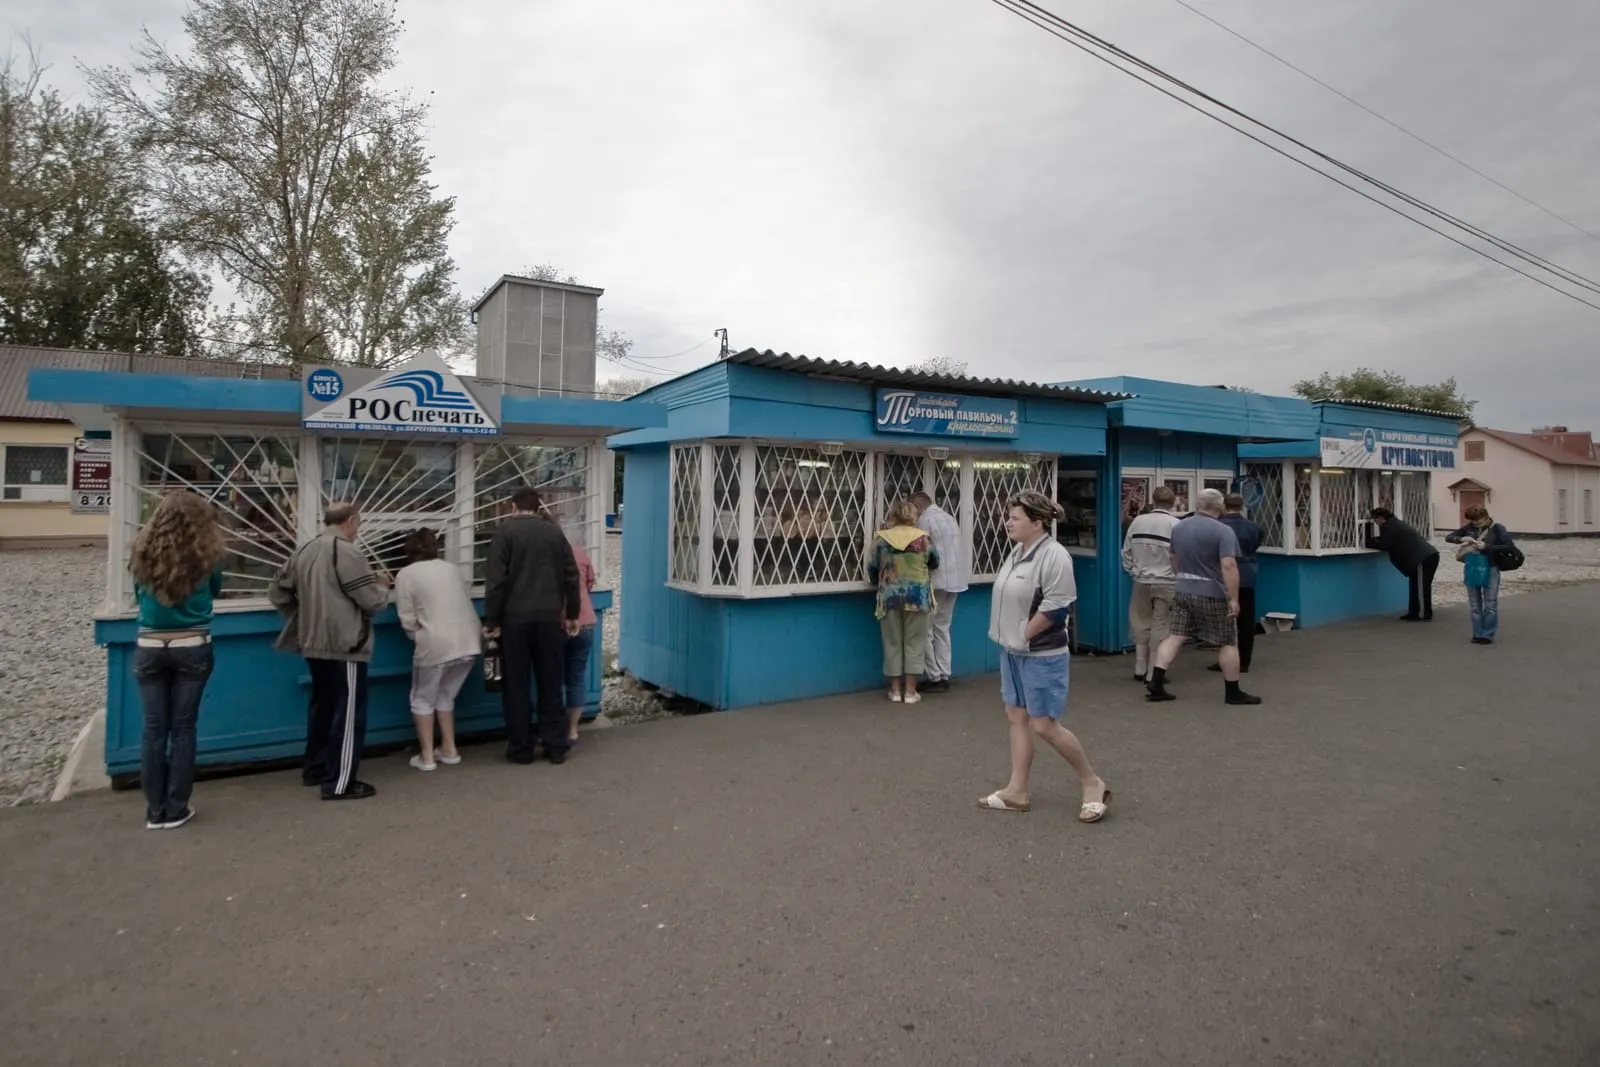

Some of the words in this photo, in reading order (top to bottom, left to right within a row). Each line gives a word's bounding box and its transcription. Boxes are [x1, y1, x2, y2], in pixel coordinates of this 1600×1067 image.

[311, 382, 339, 395] №15
[348, 398, 485, 425] РОСпечать
[957, 411, 1004, 423] ПАВИЛЬОН
